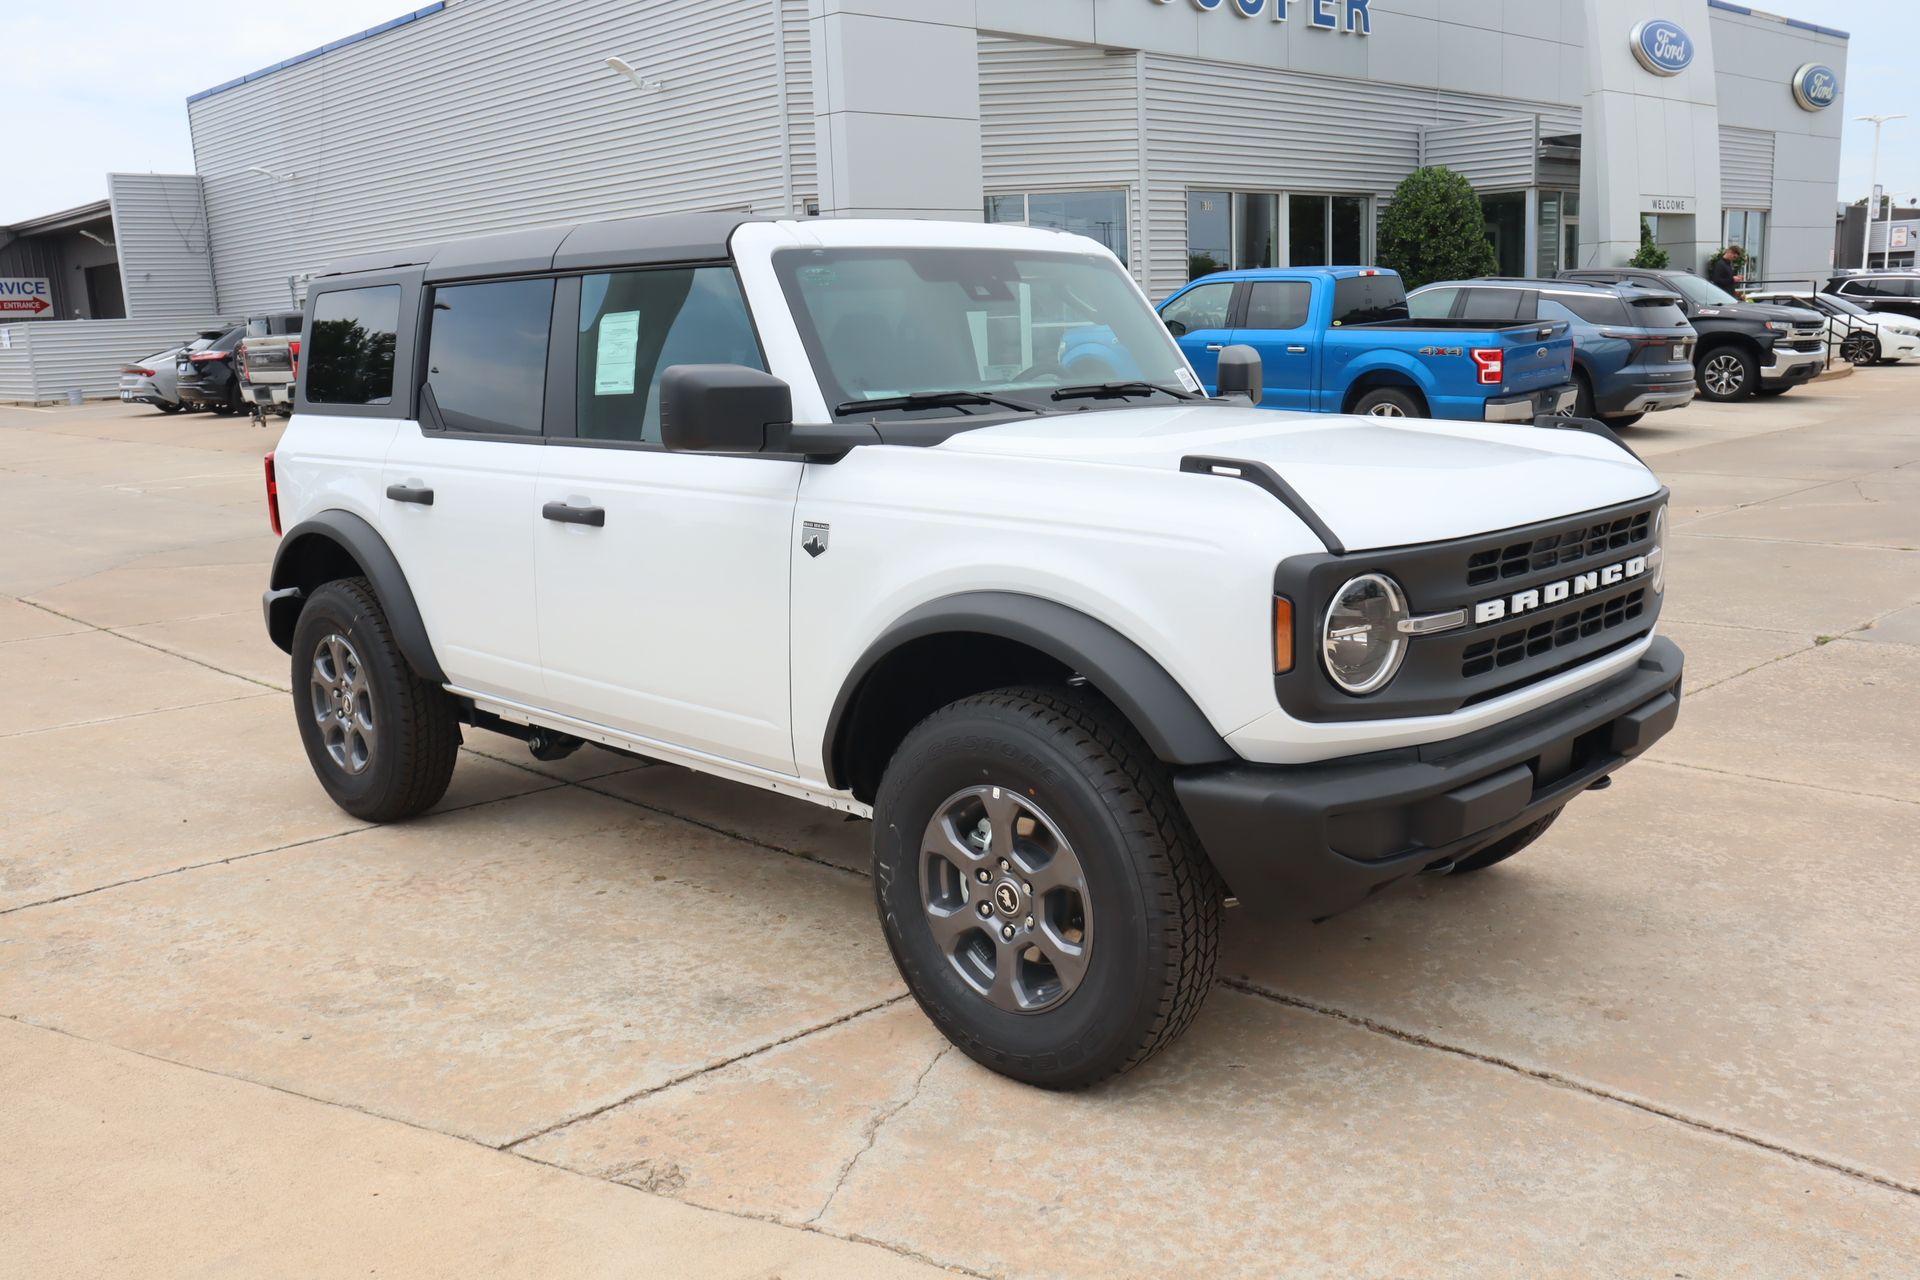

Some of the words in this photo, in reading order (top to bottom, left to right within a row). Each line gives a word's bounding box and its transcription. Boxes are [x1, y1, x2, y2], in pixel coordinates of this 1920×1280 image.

[1654, 28, 1685, 61] Ford
[1810, 73, 1834, 99] Ford
[1652, 199, 1685, 210] WELCOME
[3, 301, 41, 309] ENTRANCE
[1475, 556, 1645, 624] BRONCO
